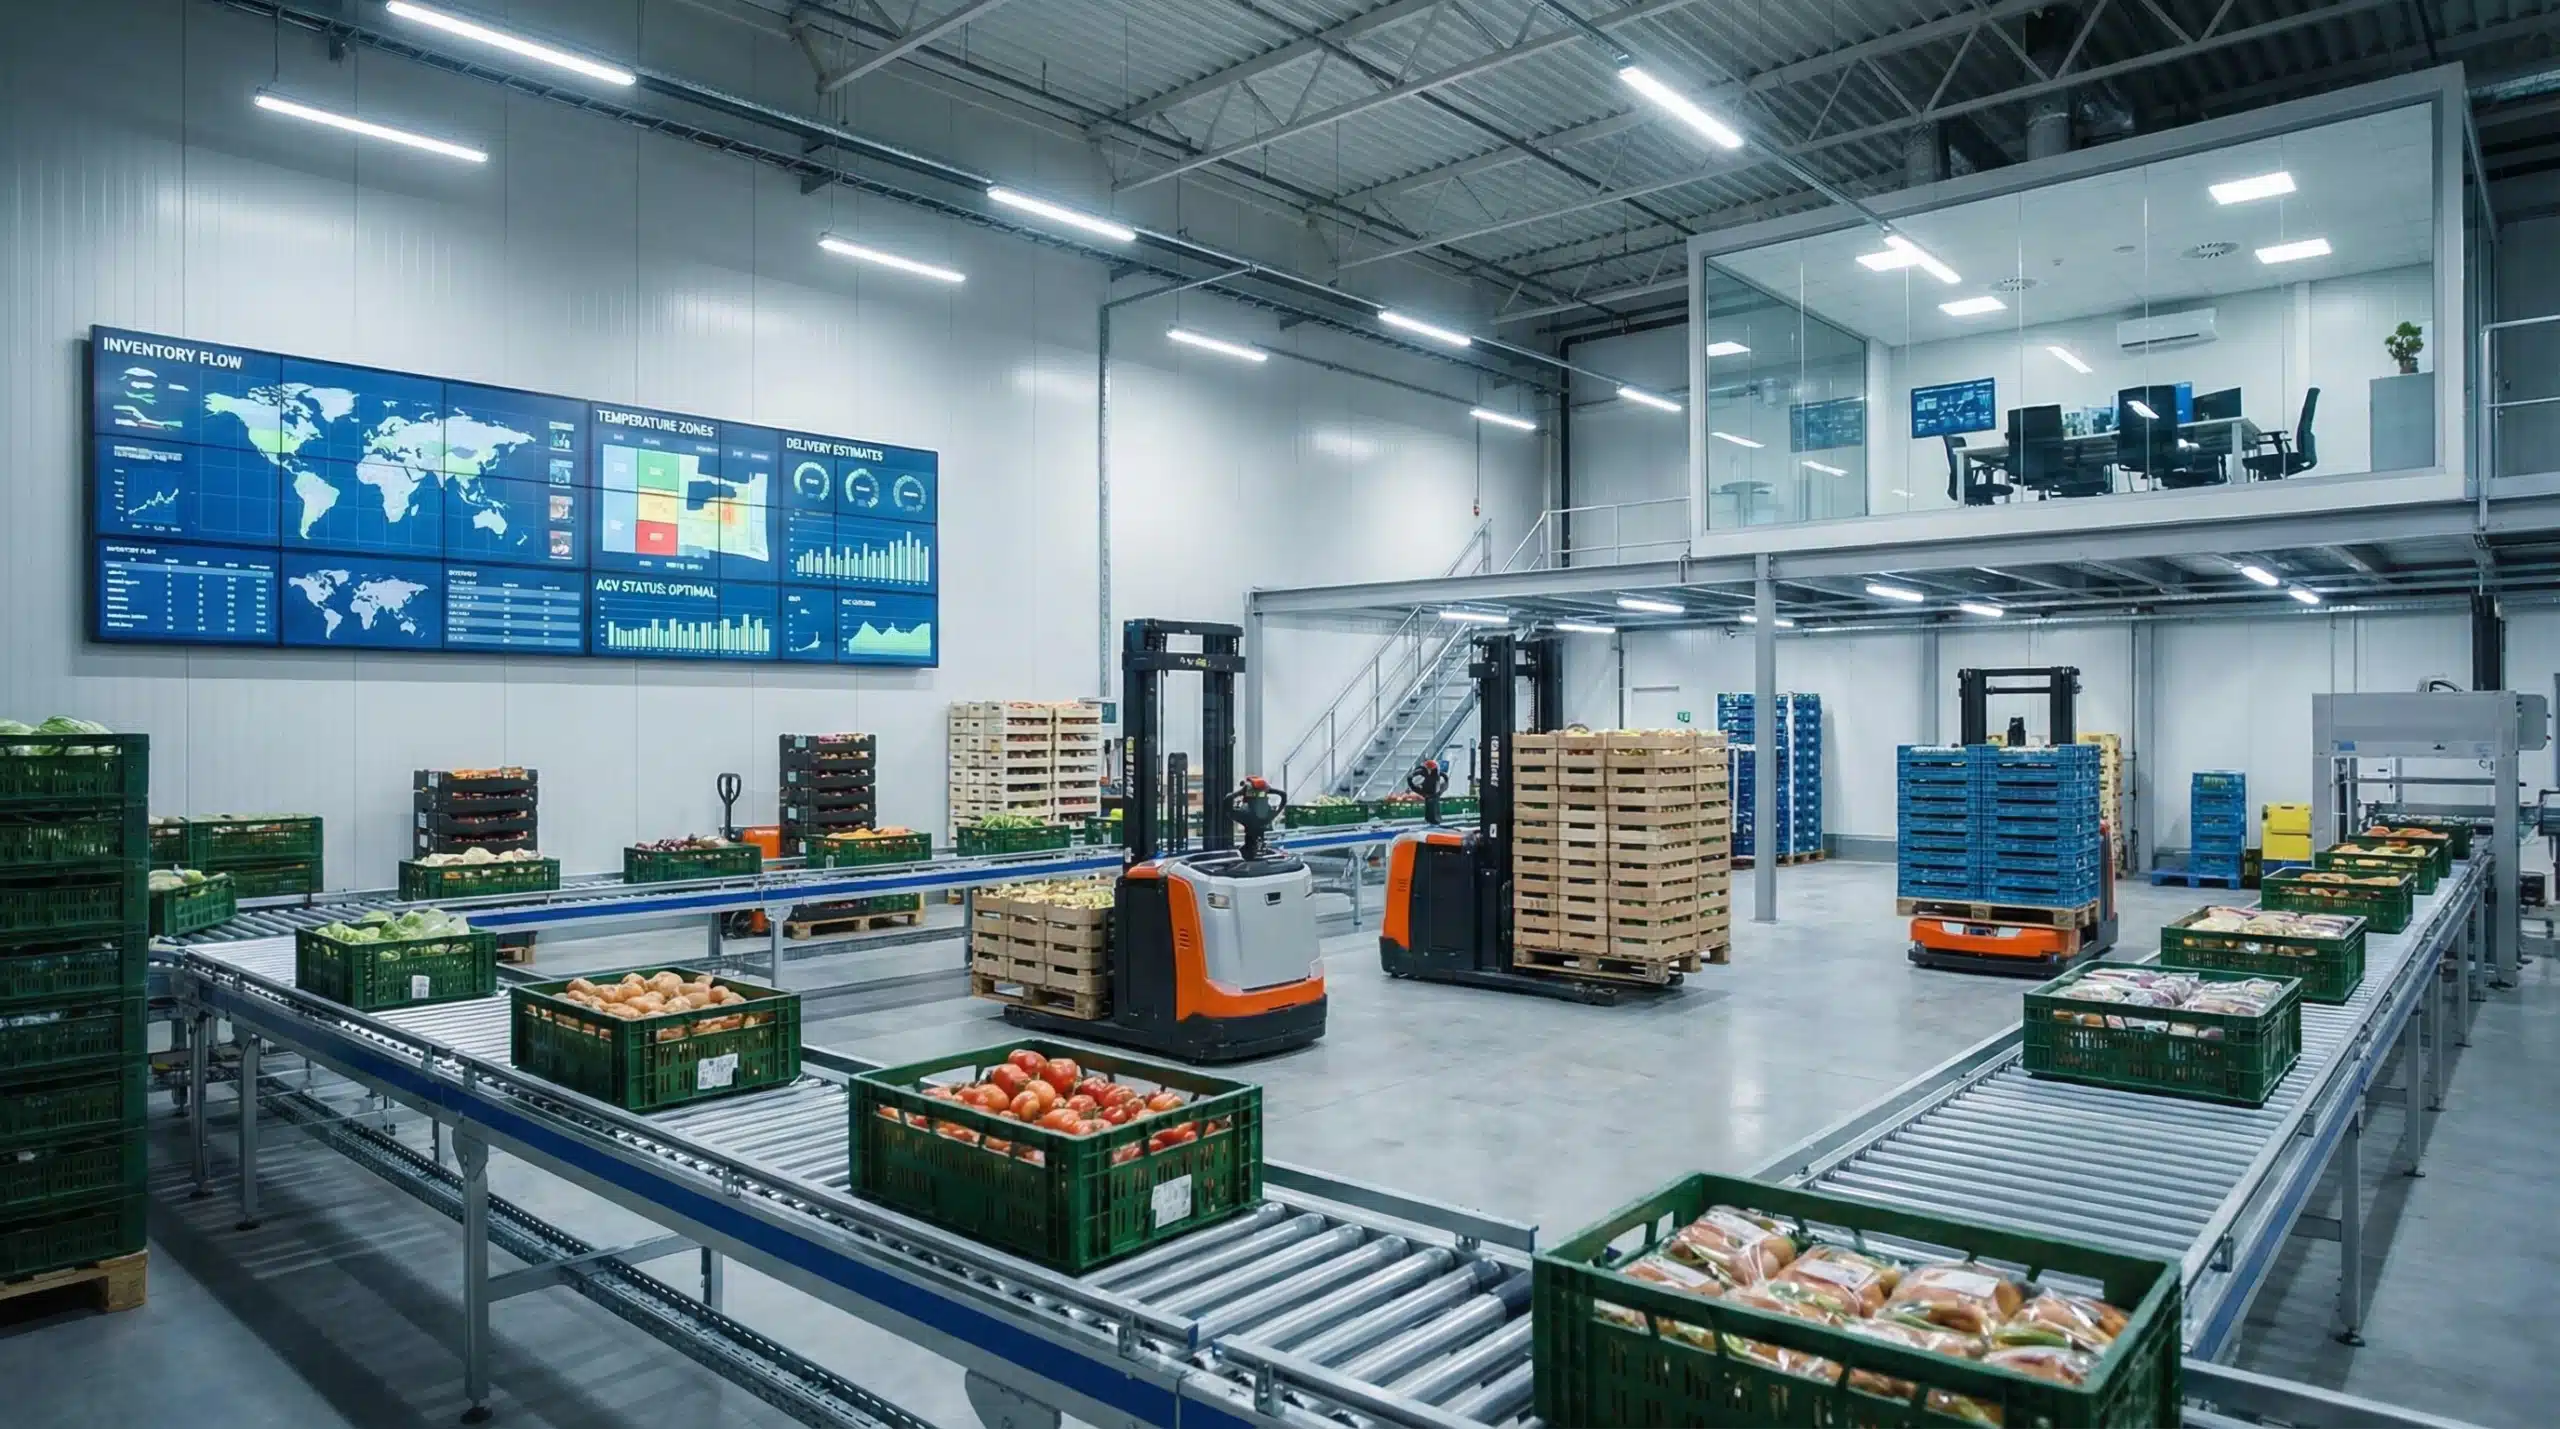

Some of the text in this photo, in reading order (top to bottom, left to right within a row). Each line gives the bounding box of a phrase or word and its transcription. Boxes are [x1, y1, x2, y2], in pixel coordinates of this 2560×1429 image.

[103, 337, 243, 370] INVENTORY FLOW
[597, 409, 714, 437] TEMPERATURE ZONES
[786, 437, 884, 462] DELIVERY ESTIMATES
[596, 579, 620, 592] AGV
[668, 583, 717, 598] OPTIMAL
